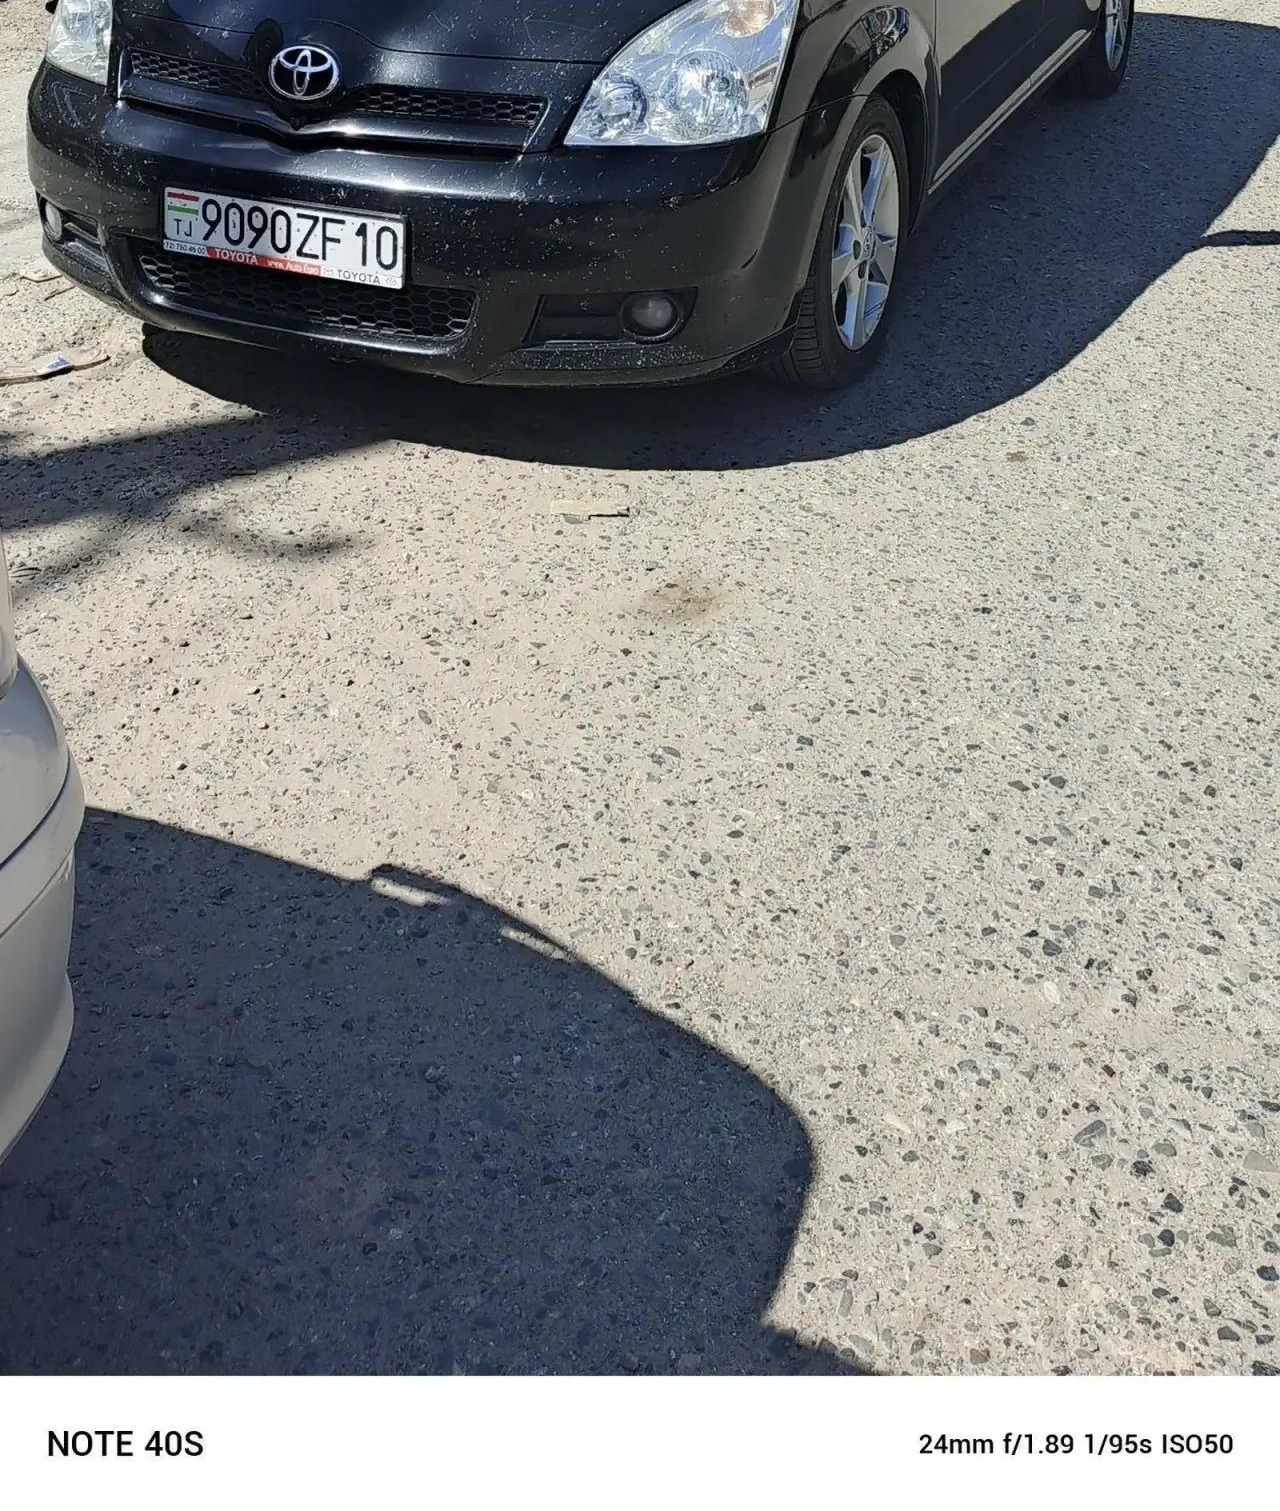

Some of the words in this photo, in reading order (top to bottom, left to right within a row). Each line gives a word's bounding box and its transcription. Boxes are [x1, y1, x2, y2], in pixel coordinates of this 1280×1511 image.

[174, 218, 193, 238] TJ
[215, 249, 259, 266] TOYOTA
[337, 269, 380, 285] TOYOTA
